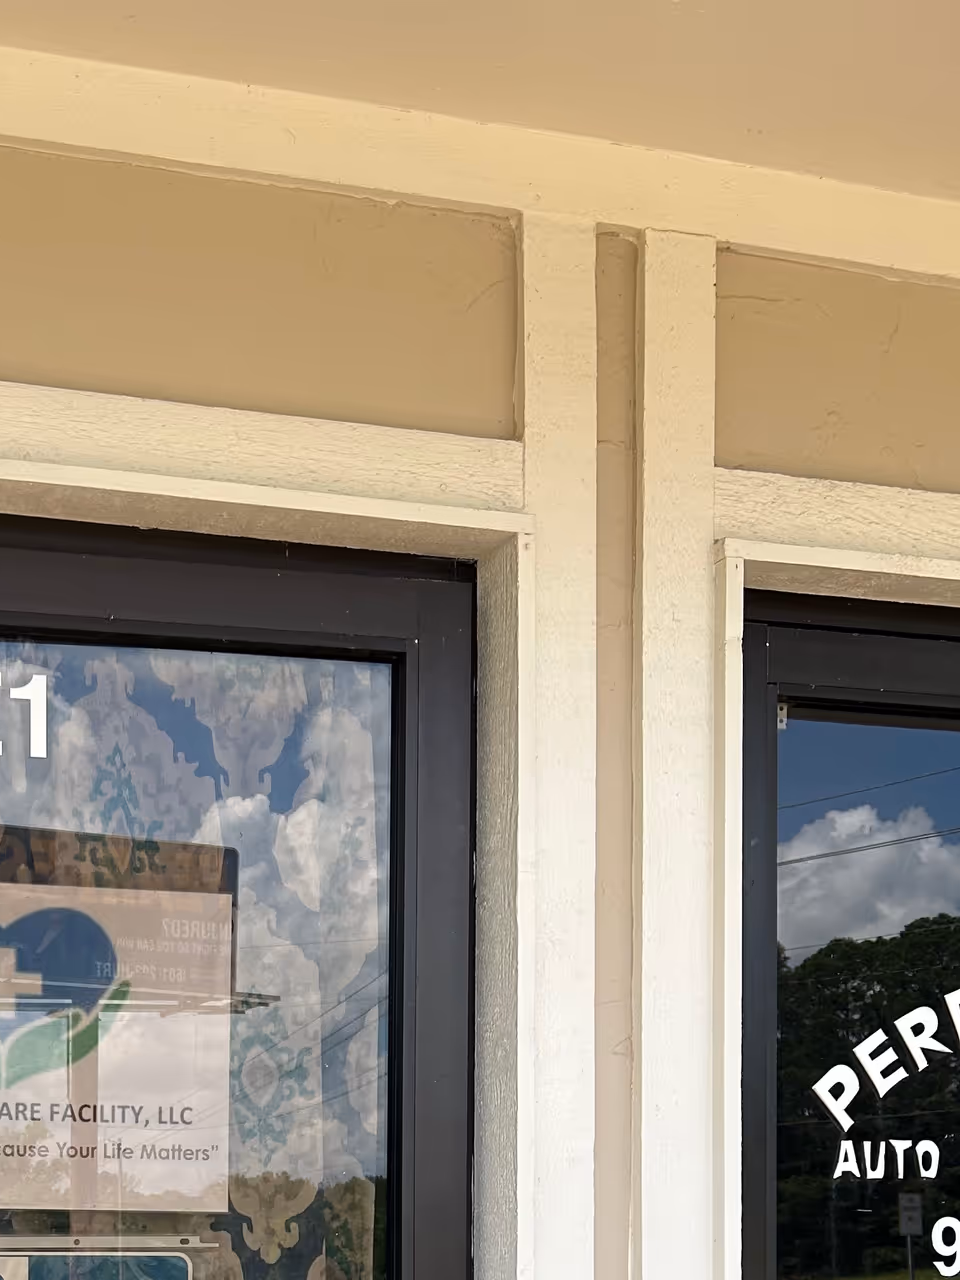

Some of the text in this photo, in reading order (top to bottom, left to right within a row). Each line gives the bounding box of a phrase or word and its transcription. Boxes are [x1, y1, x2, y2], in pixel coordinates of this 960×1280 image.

[49, 1103, 150, 1127] FACILITY,
[157, 1106, 194, 1125] LLC
[56, 1142, 98, 1159] Your
[103, 1143, 134, 1160] Life
[140, 1144, 219, 1161] Matters”
[833, 1139, 940, 1179] AUTO
